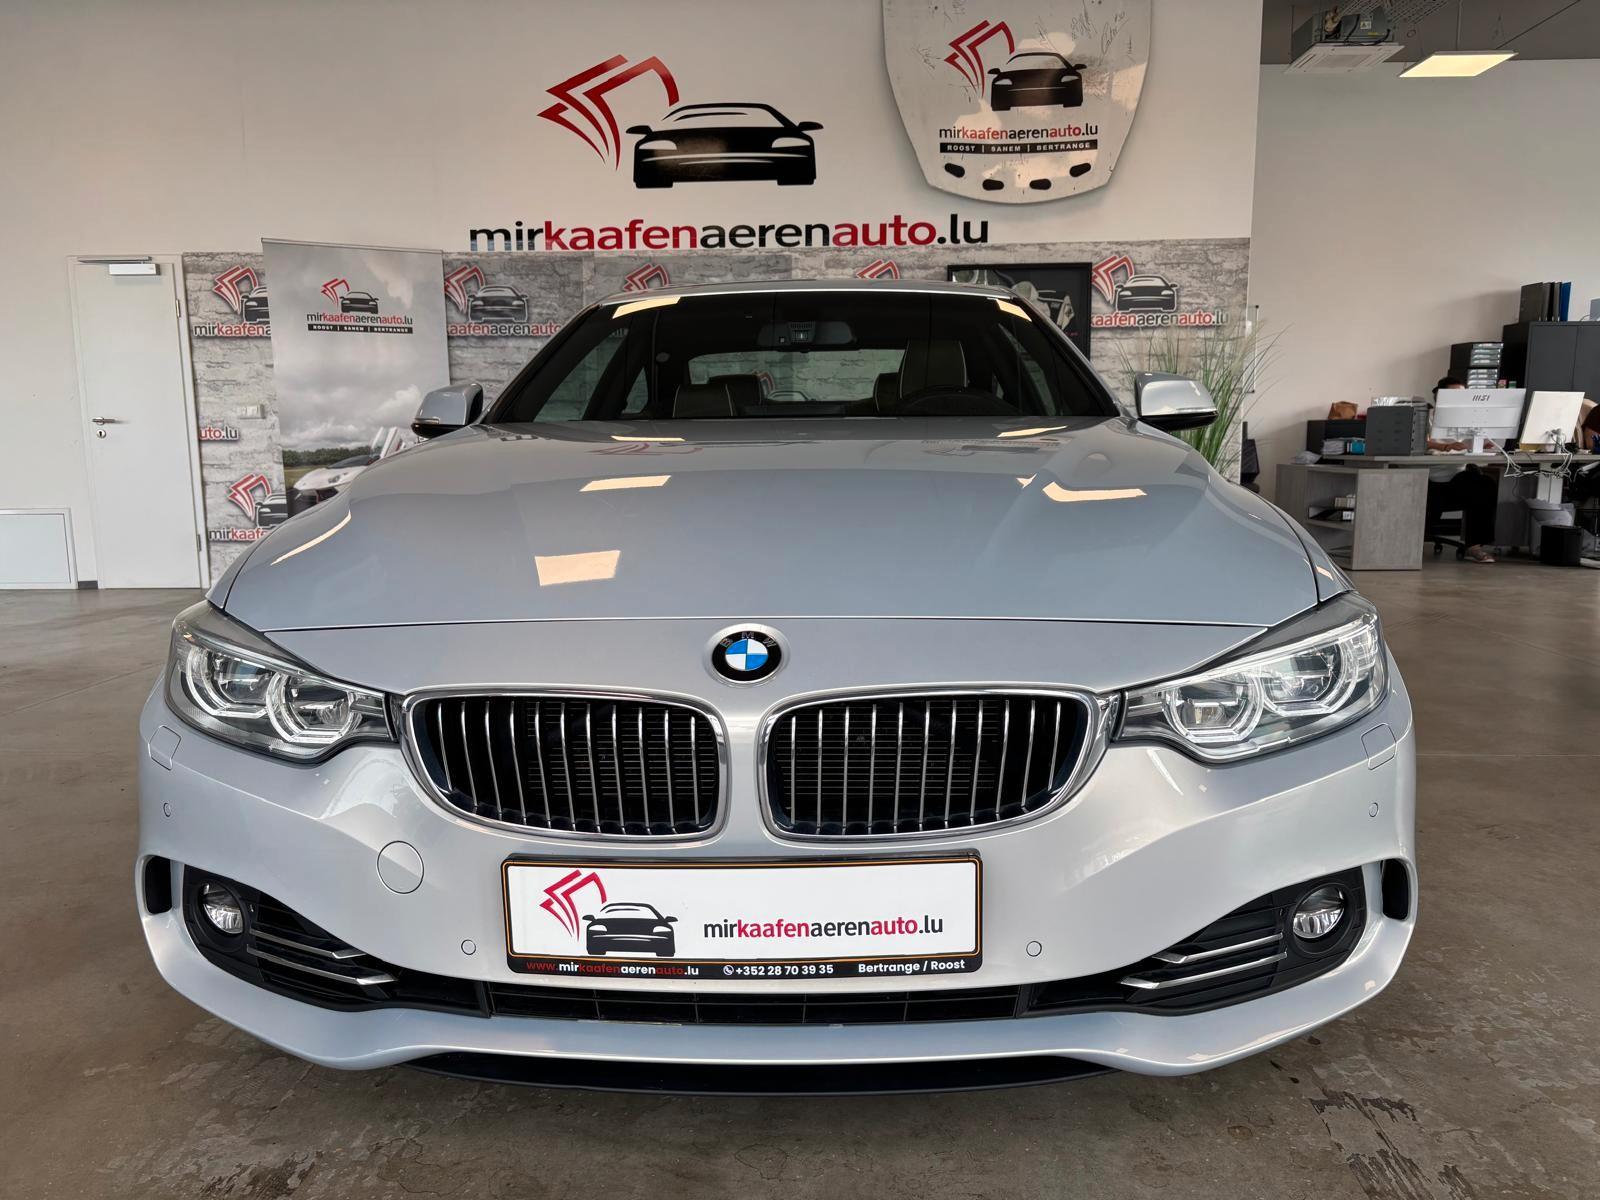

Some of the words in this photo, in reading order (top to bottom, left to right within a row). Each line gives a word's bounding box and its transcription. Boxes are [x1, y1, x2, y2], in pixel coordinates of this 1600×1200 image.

[939, 123, 1098, 140] mirkaafenaerenauto.lu
[1036, 142, 1091, 151] BERTRANGE
[469, 213, 989, 252] mirkaafenaerenauto.lu
[307, 312, 413, 325] mirkaafenaerenauto.lu
[1472, 394, 1491, 402] MSI
[720, 631, 777, 648] BMW
[703, 915, 944, 938] mirkaafenaerenauto.lu
[526, 961, 699, 976] www.mirkaafenaerenauto.lu
[735, 965, 766, 976] +352
[767, 965, 782, 976] 28
[784, 965, 799, 976] 70
[801, 964, 816, 976] 39
[818, 964, 834, 975] 35
[858, 961, 921, 974] Bertrange
[930, 959, 966, 971] Roost
